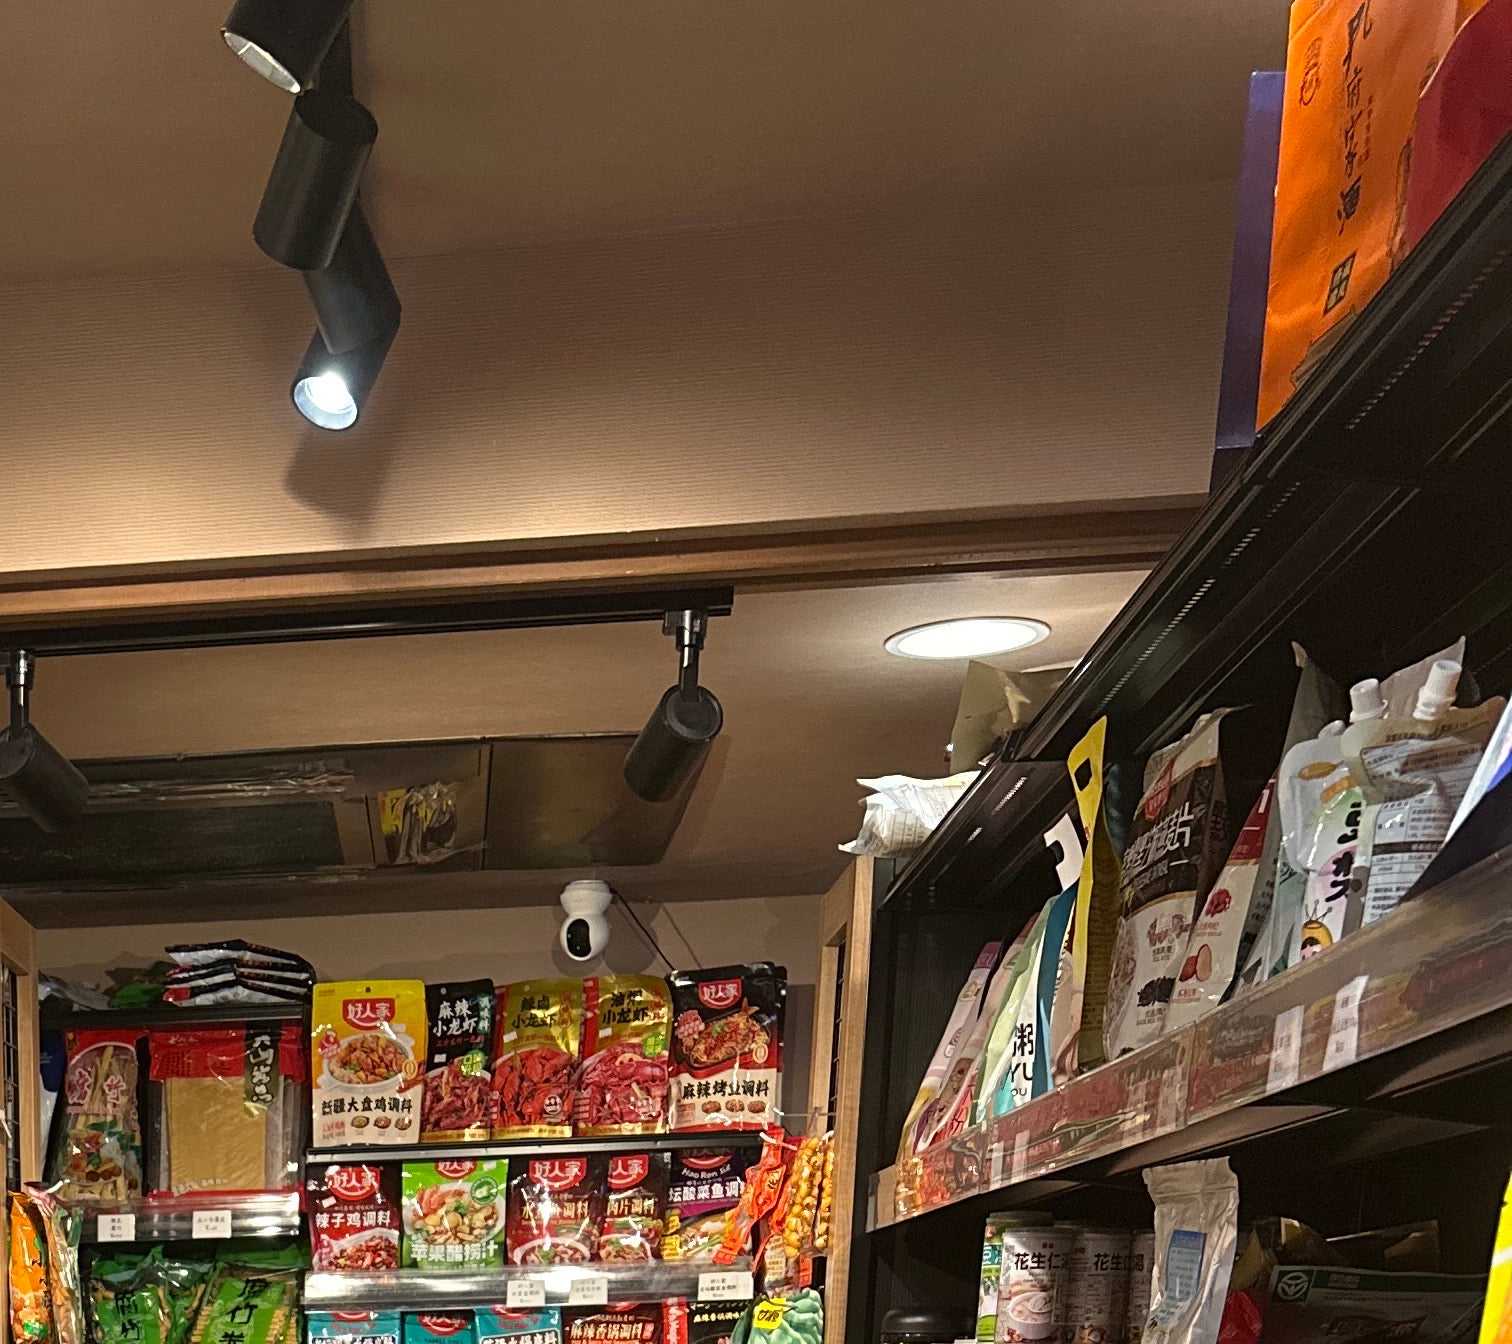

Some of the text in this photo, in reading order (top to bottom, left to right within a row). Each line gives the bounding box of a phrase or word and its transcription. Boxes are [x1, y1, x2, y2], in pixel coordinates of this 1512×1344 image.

[702, 983, 740, 1000] 好人家
[346, 1001, 392, 1021] 好人家
[438, 999, 473, 1019] 麻辣
[602, 1007, 649, 1024] 小龙虾
[432, 1017, 477, 1037] 小龙虾
[511, 1013, 556, 1029] 小龙虾
[682, 1079, 770, 1100] 麻辣烤鱼调料
[320, 1095, 413, 1116] 新疆大盘鸡调料
[533, 1158, 583, 1177] 好人家
[607, 1159, 645, 1175] 人家
[333, 1169, 378, 1188] 好人家
[315, 1210, 392, 1229] 辣子鸡调料
[569, 1323, 643, 1341] 麻辣香锅调料
